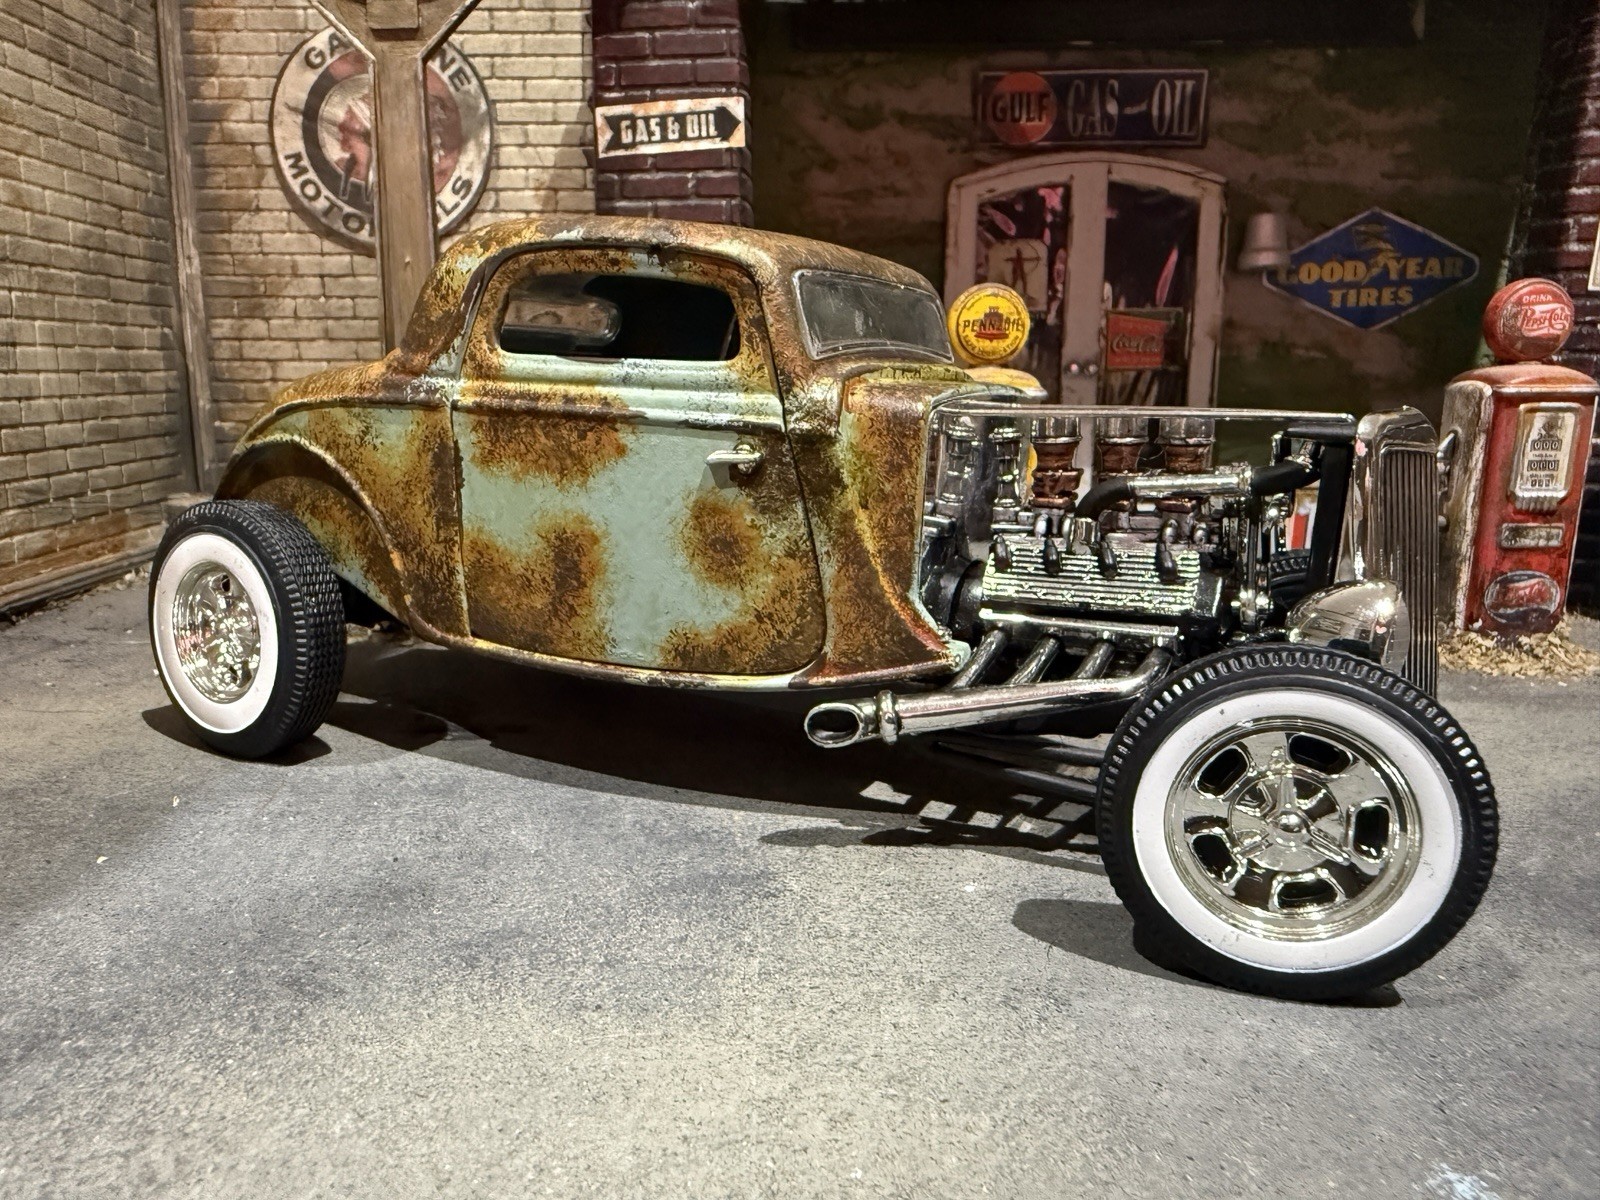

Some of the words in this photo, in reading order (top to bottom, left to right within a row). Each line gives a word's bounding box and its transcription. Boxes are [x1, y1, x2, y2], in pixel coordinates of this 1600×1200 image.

[991, 91, 1051, 123] GULF
[1067, 79, 1119, 137] GAS
[1152, 79, 1197, 136] OIL
[620, 117, 661, 144] GAS
[666, 116, 680, 140] &
[686, 113, 718, 138] OIL
[1328, 285, 1413, 308] TIRES
[1522, 294, 1553, 303] DRINK
